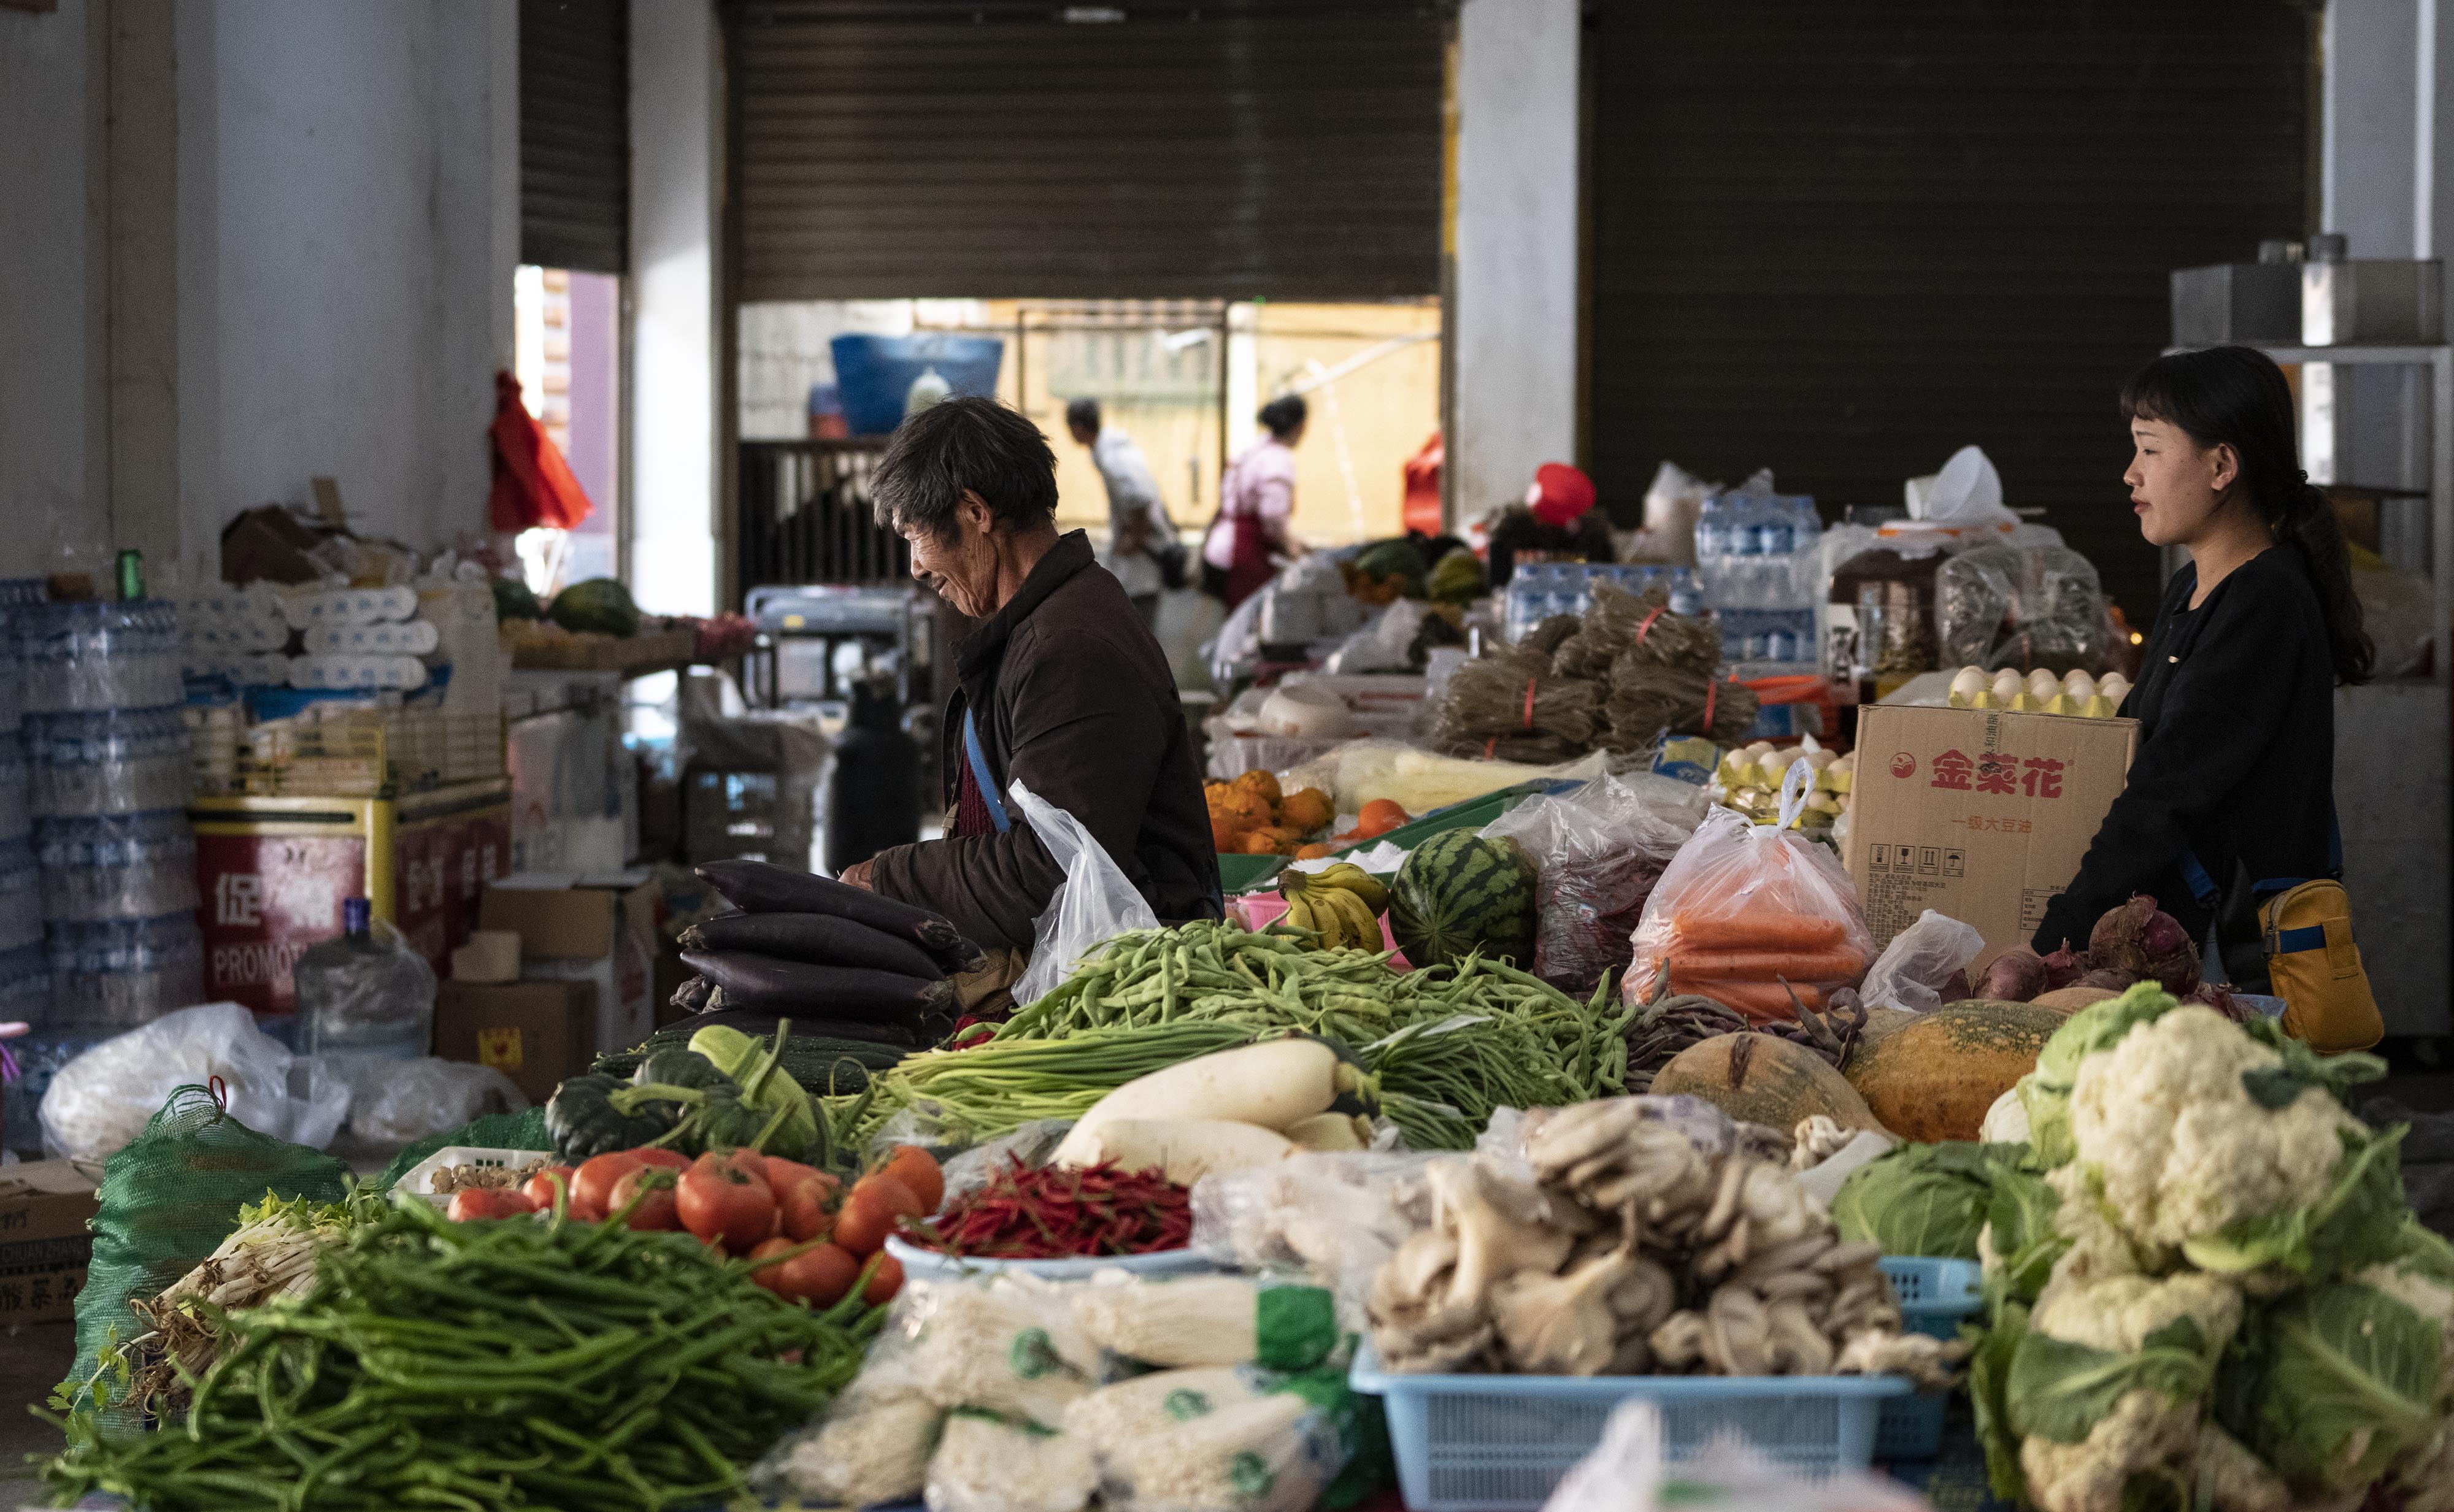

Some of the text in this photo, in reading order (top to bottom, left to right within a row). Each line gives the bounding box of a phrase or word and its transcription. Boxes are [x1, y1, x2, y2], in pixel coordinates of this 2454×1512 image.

[1931, 749, 2064, 798] 金菜花
[1952, 815, 2033, 834] 一级大豆油
